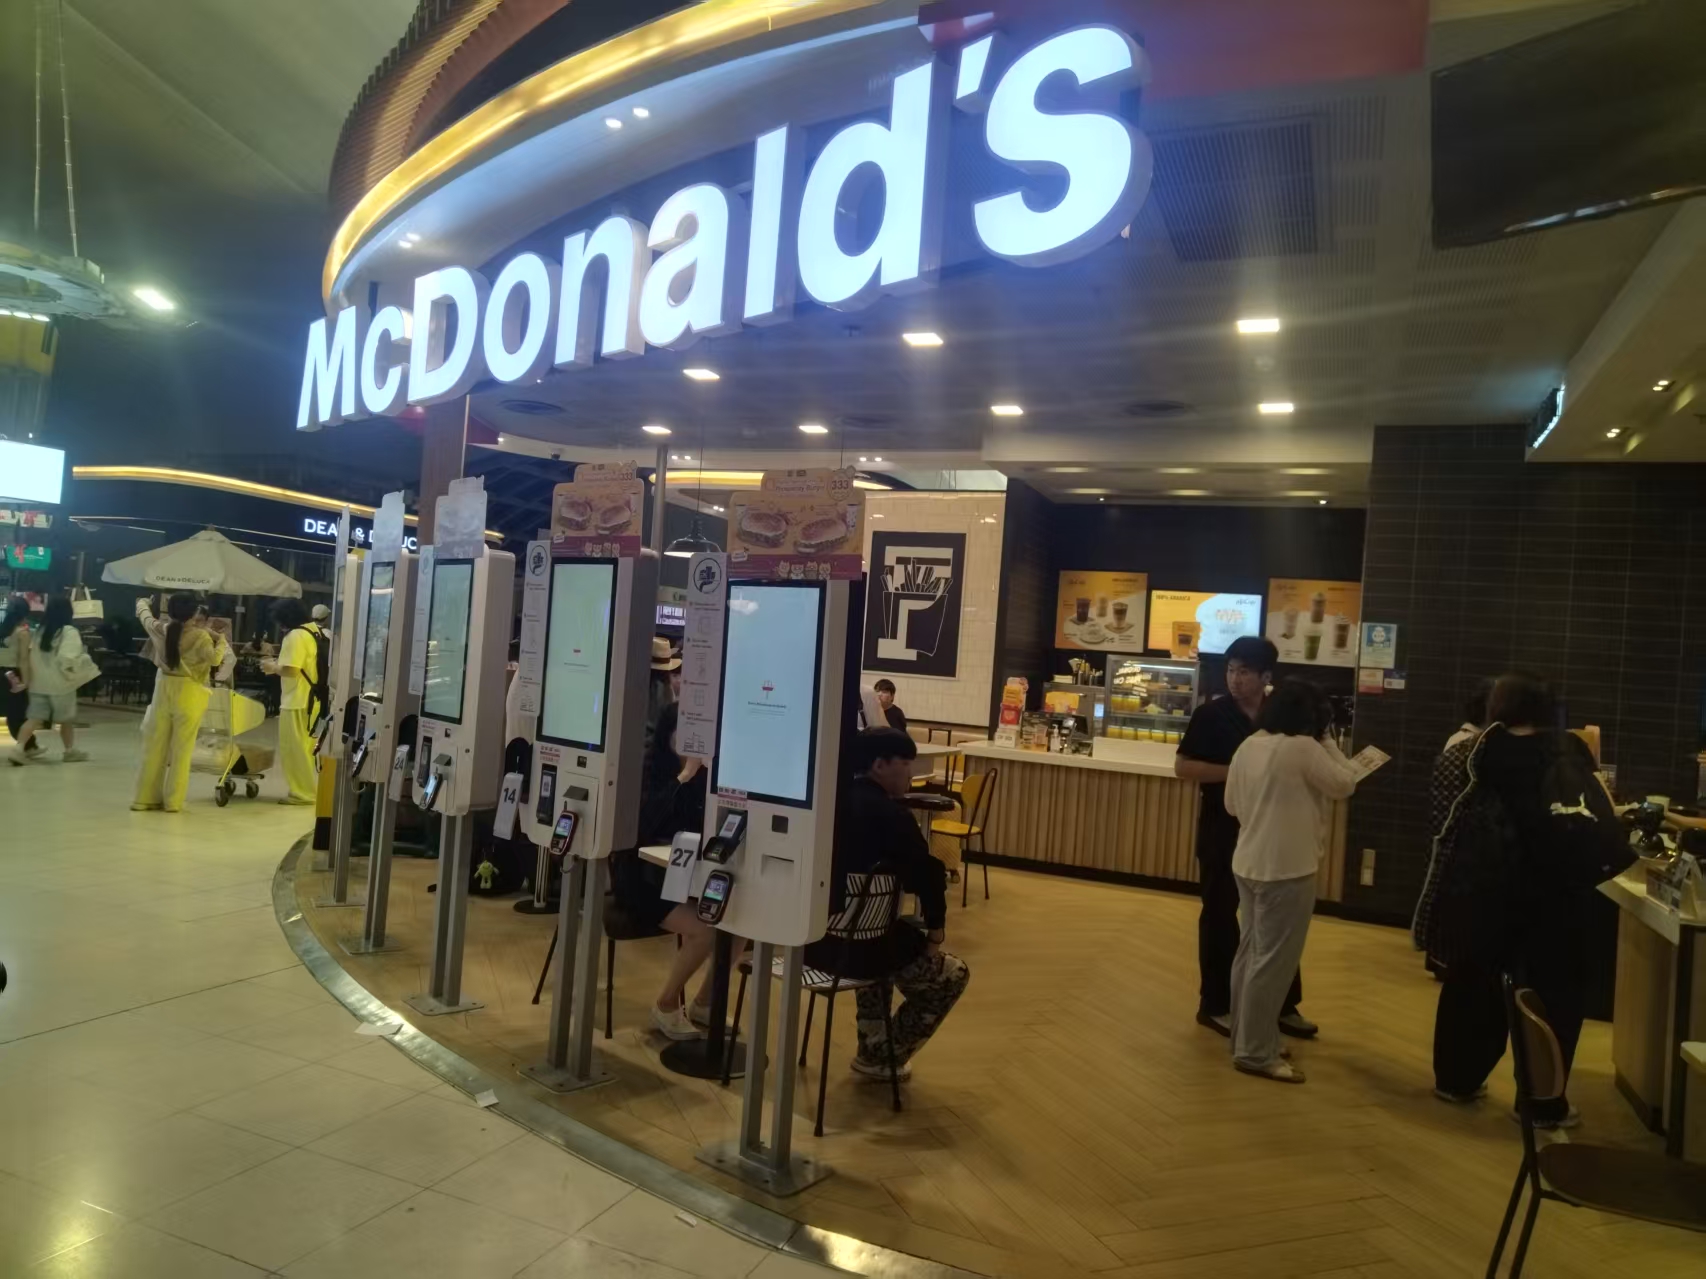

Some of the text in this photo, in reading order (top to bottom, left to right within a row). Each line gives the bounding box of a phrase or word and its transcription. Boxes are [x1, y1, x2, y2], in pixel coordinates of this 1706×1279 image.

[295, 23, 1140, 430] McDonald's
[831, 479, 849, 490] 333
[304, 518, 365, 538] DEA &
[503, 787, 517, 804] 14
[671, 848, 694, 868] 27
